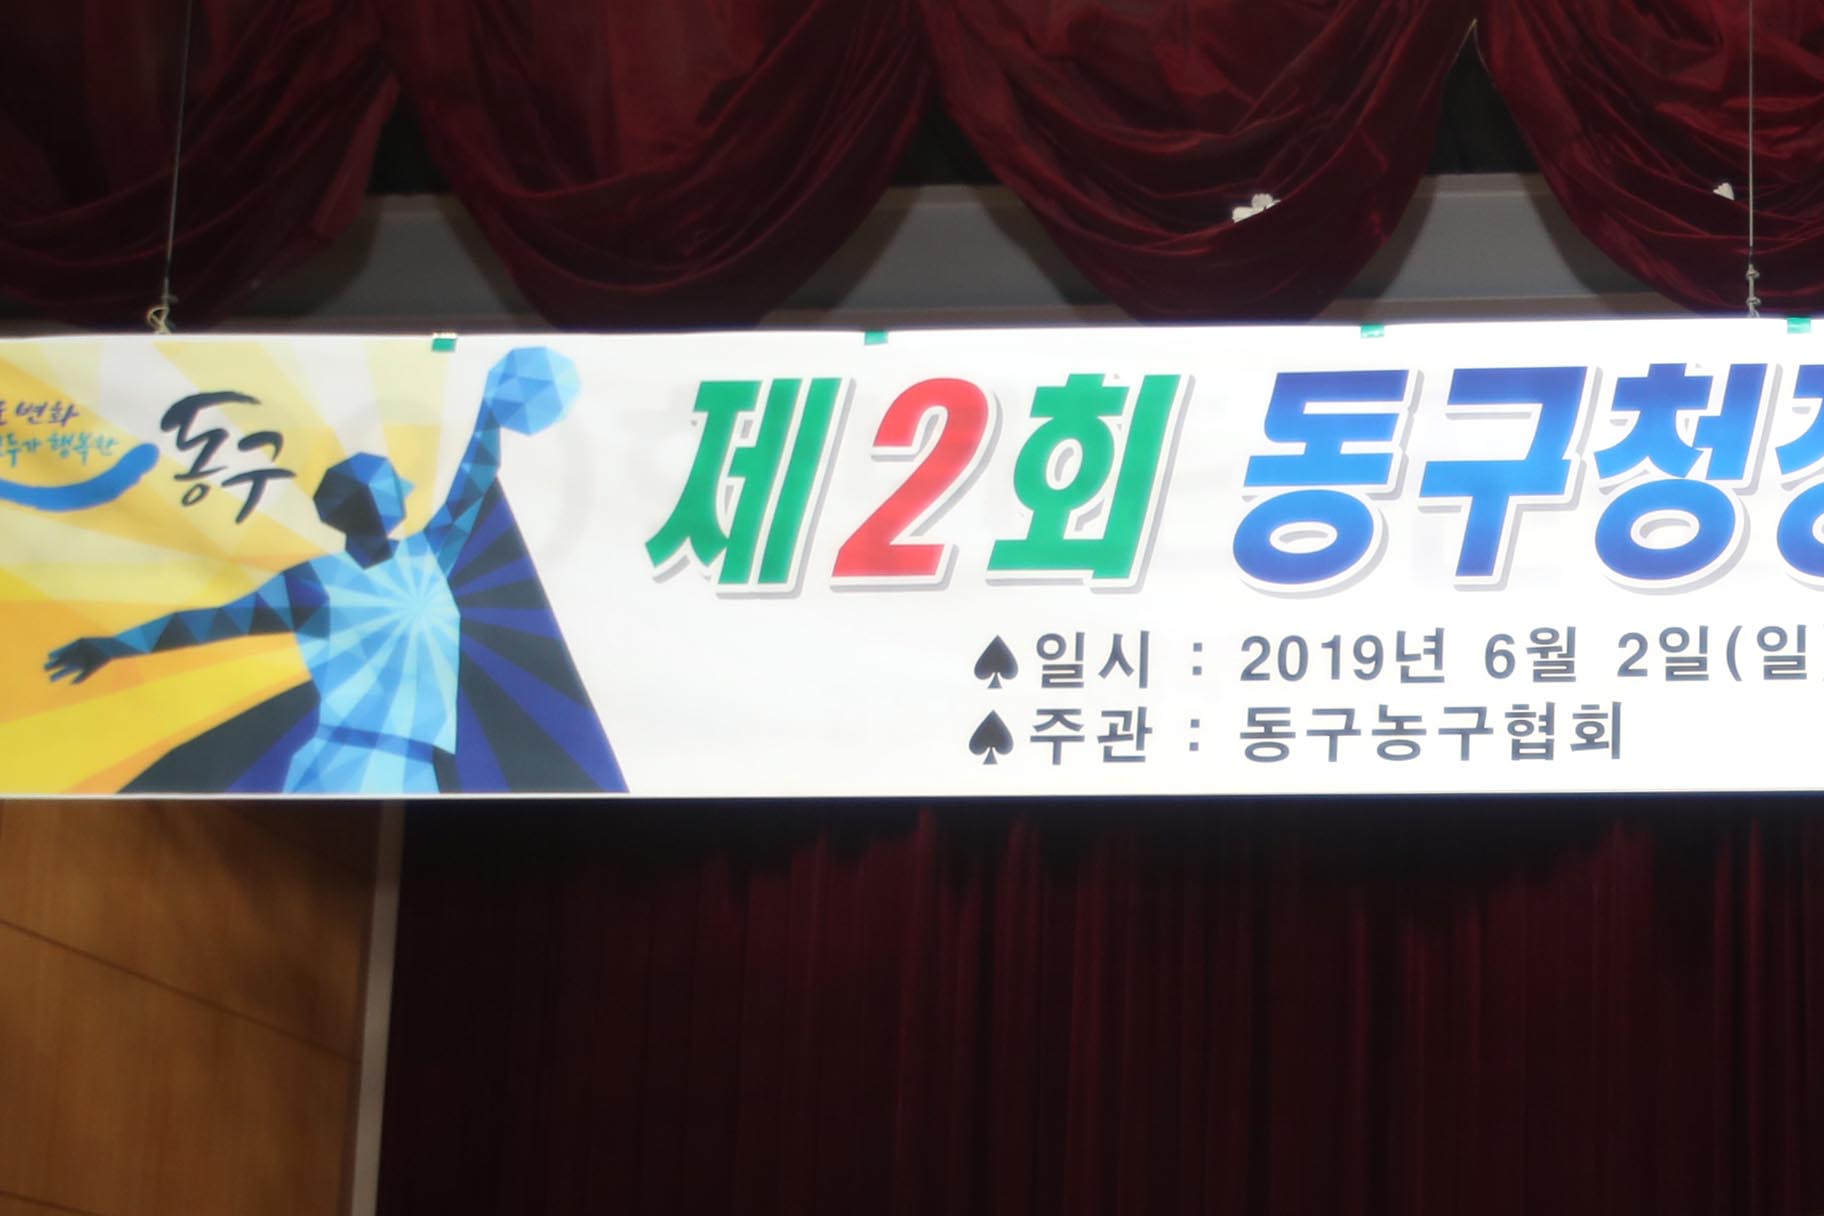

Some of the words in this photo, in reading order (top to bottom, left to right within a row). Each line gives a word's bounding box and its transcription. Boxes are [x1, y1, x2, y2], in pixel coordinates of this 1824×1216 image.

[15, 400, 79, 426] 변화
[0, 432, 42, 467] 두가
[160, 391, 296, 524] 동구
[645, 371, 1180, 586] 제2회
[1035, 630, 1150, 689] 일시
[1239, 626, 1446, 684] 2019년
[1484, 625, 1577, 683] 6월
[1029, 706, 1154, 766] 주관
[1239, 700, 1624, 763] 동구농구협회
